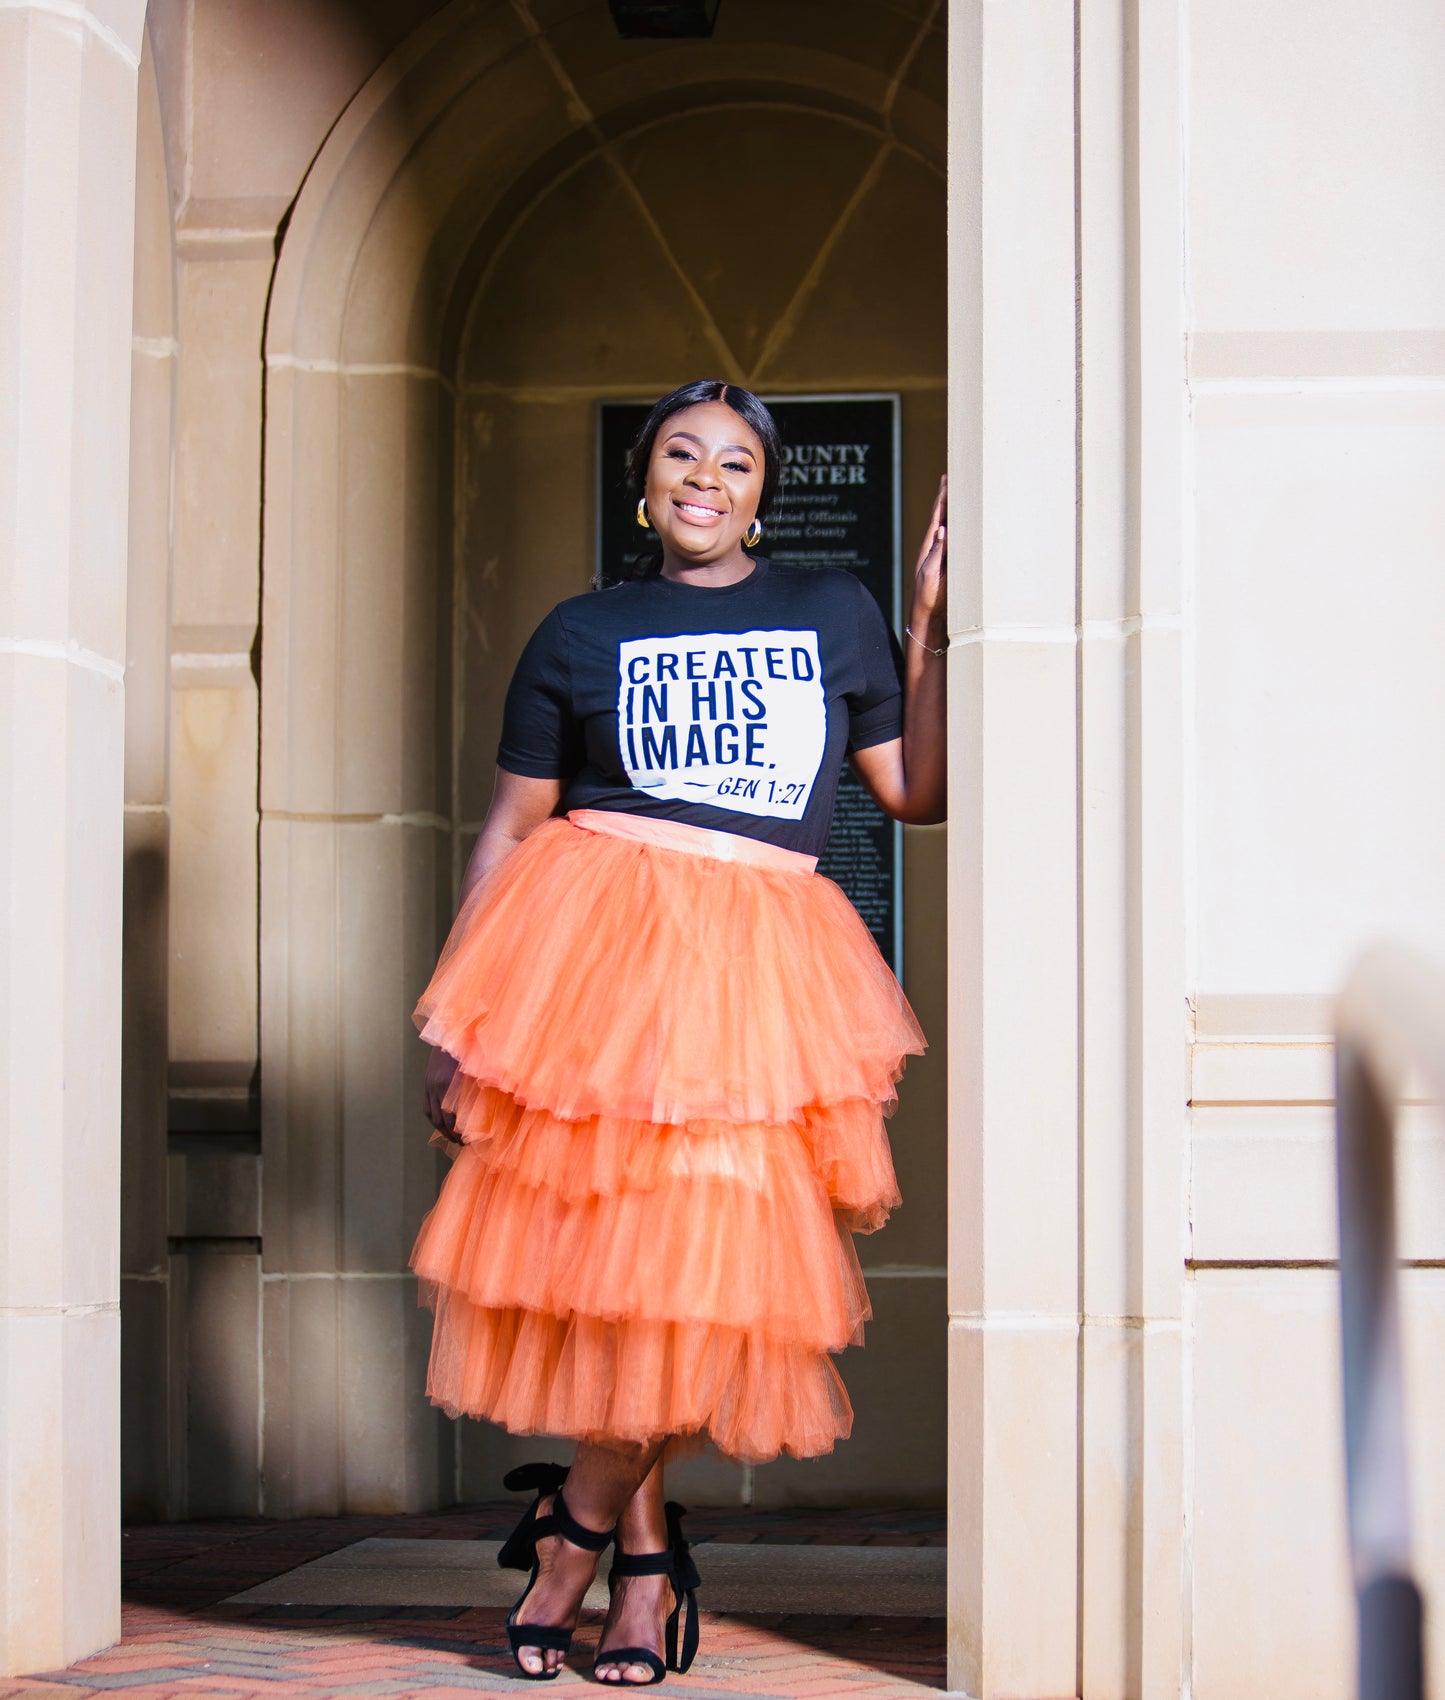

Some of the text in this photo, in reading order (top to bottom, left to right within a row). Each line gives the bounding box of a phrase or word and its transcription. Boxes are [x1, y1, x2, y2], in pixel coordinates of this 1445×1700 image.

[627, 647, 815, 685] CREATED
[626, 679, 767, 725] IN HIS
[626, 723, 776, 771] IMAGE.
[717, 777, 807, 805] GEN 1:27
